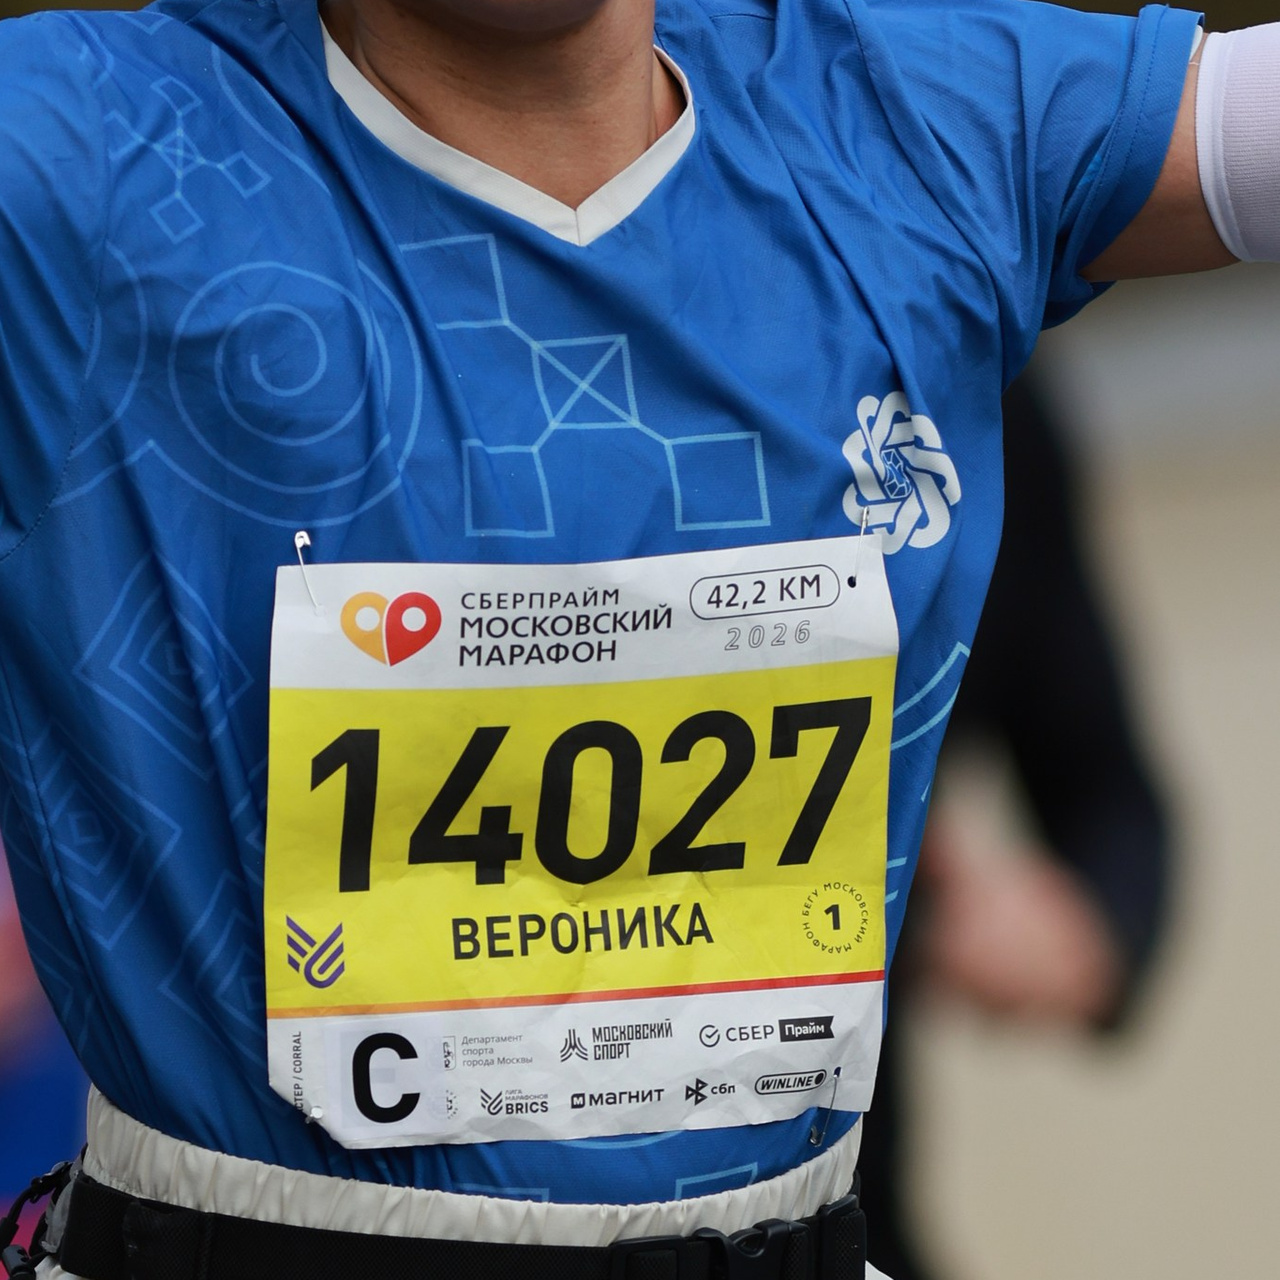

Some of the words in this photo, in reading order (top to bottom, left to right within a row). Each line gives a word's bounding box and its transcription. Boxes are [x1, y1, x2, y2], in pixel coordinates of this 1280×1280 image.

[461, 587, 620, 610] СБЕРПРАЙМ
[706, 579, 766, 610] 42,2
[780, 573, 821, 601] КМ
[460, 603, 673, 638] МОСКОВСКИЙ
[724, 619, 811, 651] 2026
[459, 639, 617, 667] МАРАФОН
[310, 696, 872, 893] 14027
[823, 882, 868, 943] МОСКОВСКИЙ
[824, 903, 841, 930] 1
[452, 901, 714, 961] ВЕРОНИКА
[802, 922, 852, 954] МАРАФОН
[461, 1033, 523, 1045] Департамент
[592, 1018, 673, 1043] МОСКОВСКИЙ
[726, 1024, 774, 1042] СБЕР
[784, 1022, 825, 1037] Прайм
[292, 1031, 302, 1073] CORRAL
[462, 1047, 494, 1058] спорта
[463, 1058, 495, 1069] города
[497, 1055, 533, 1066] Москвы
[593, 1042, 630, 1061] СПОРТ
[352, 1032, 420, 1124] C
[760, 1077, 813, 1091] WINLINE
[293, 1083, 304, 1111] СТЕР
[505, 1101, 549, 1115] BRICS
